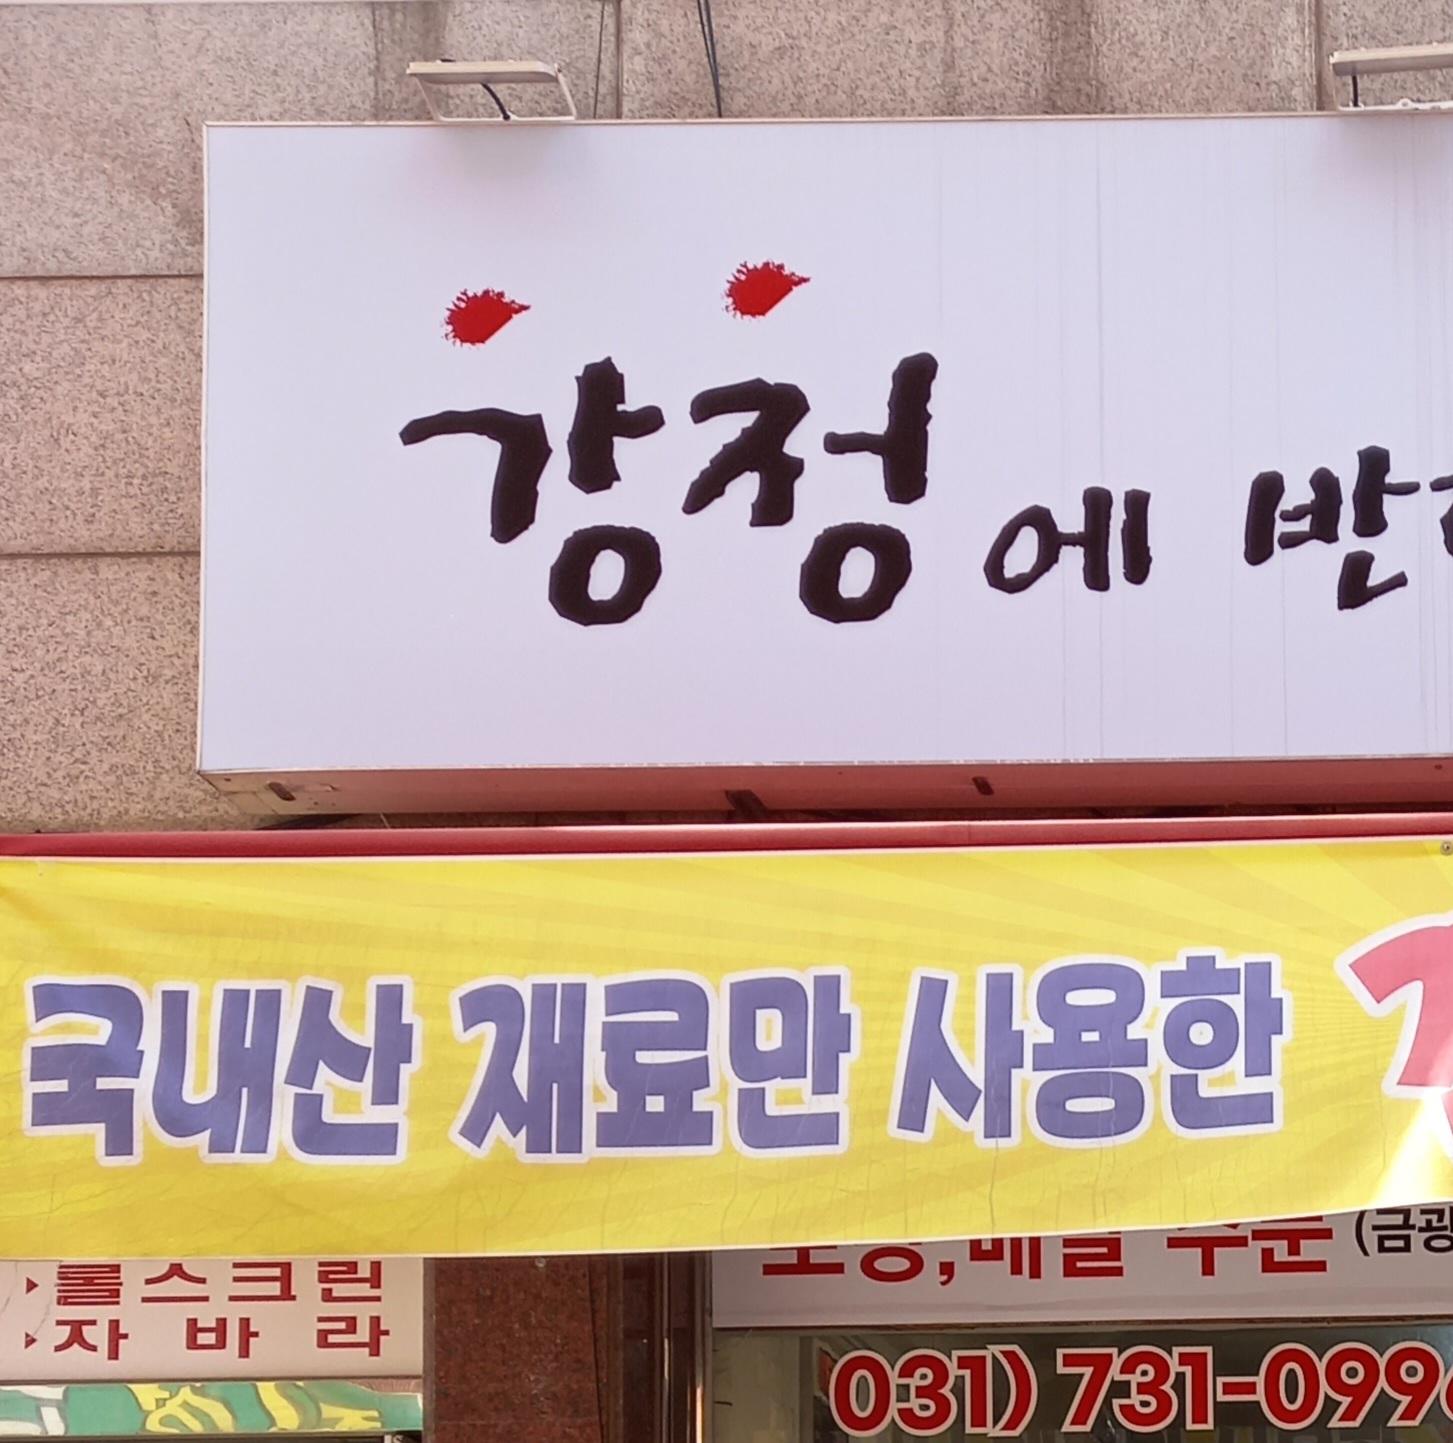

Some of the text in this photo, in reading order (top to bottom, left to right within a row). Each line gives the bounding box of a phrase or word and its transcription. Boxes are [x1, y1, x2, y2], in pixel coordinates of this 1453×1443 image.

[24, 974, 422, 1166] 국내산
[449, 970, 862, 1166] 재료만
[886, 947, 1292, 1146] 사용한
[55, 1260, 383, 1306] 롤스크린
[829, 1343, 1038, 1437] 031)
